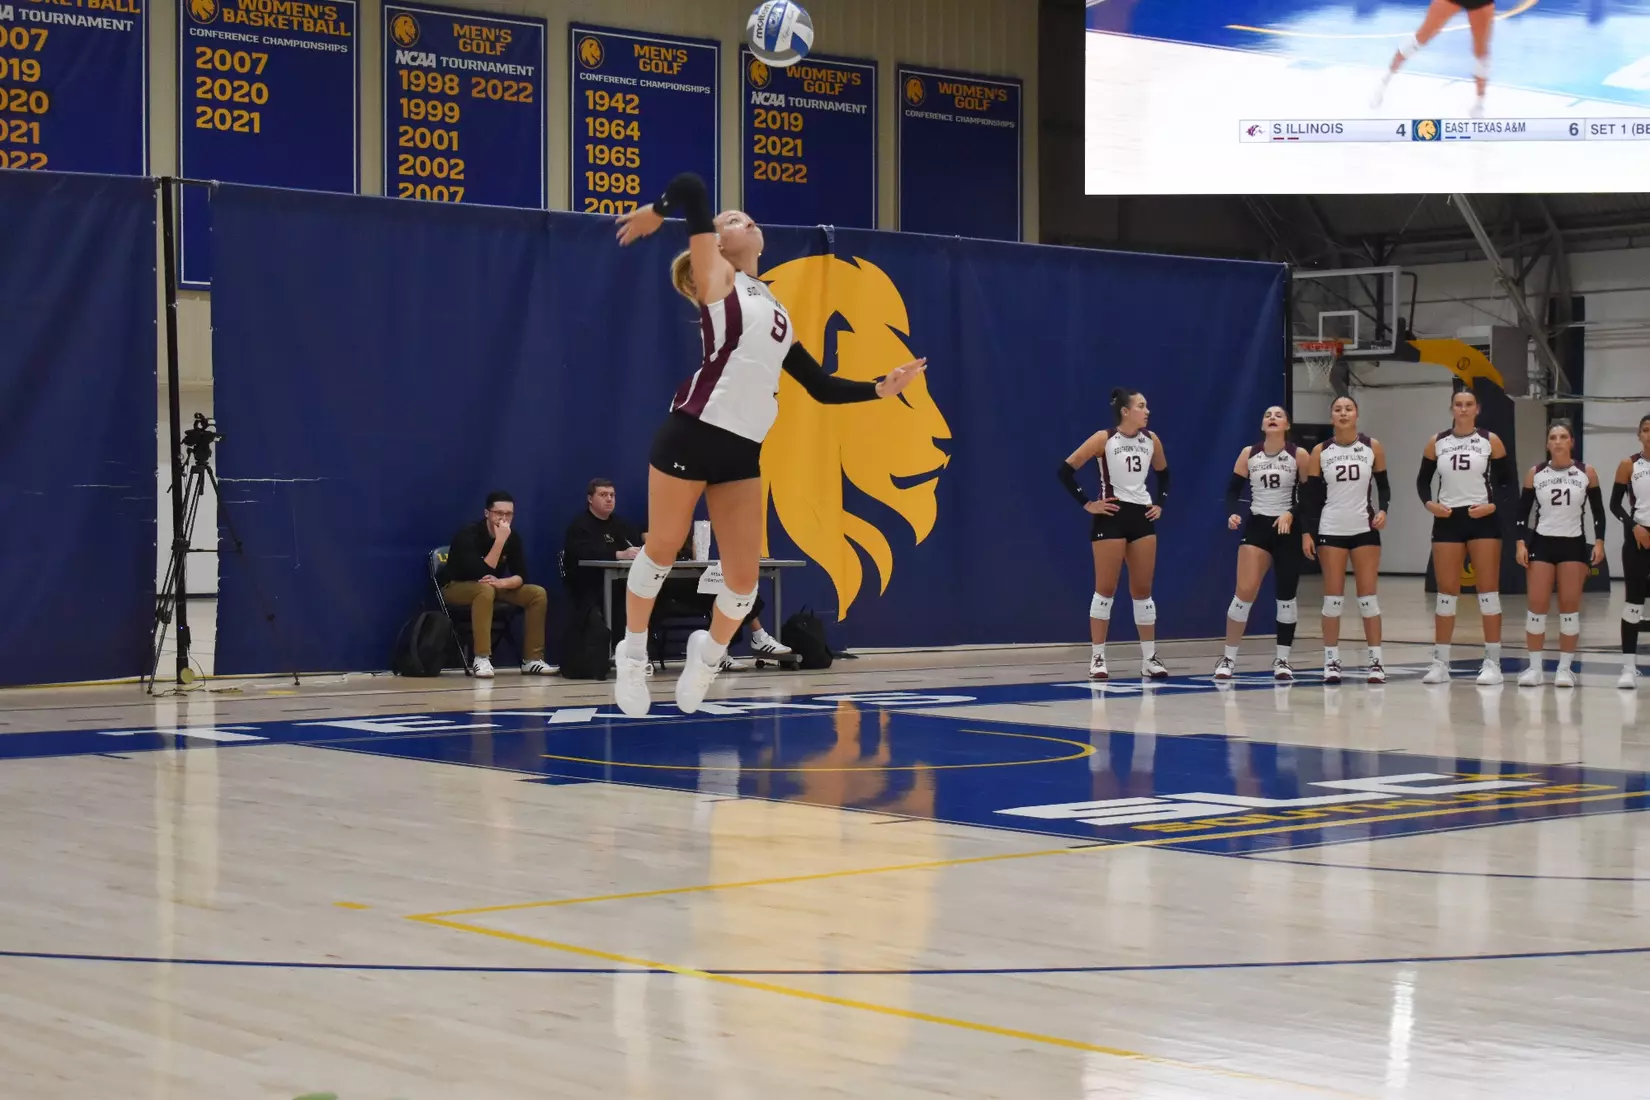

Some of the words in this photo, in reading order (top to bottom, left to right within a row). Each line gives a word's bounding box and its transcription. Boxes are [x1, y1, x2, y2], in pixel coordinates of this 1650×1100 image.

[19, 9, 134, 31] TOURNAMENT
[237, 0, 338, 20] WOMEN'S
[222, 8, 351, 36] BASKETBALL
[452, 23, 512, 43] MEN'S
[189, 27, 260, 43] CONFERENCE
[262, 36, 348, 53] CHAMPIONSHIPS
[458, 38, 506, 56] GOLF
[195, 46, 269, 75] 2007
[395, 50, 437, 69] NCAA
[440, 56, 534, 77] TOURNAMENT
[633, 44, 688, 63] MEN'S
[638, 58, 683, 75] GOLF
[787, 65, 862, 85] WOMEN'S
[195, 76, 269, 105] 2020
[399, 69, 460, 96] 1998
[471, 77, 533, 103] 2022
[579, 72, 638, 86] CONFERENCE
[639, 79, 711, 94] CHAMPIONSHIPS
[804, 79, 844, 96] GOLF
[937, 81, 1008, 102] WOMEN'S
[399, 98, 461, 124] 1999
[585, 89, 640, 115] 1942
[750, 91, 786, 108] NCAA
[787, 97, 868, 115] TOURNAMENT
[954, 96, 991, 111] GOLF
[195, 106, 261, 133] 2021
[585, 117, 641, 141] 1964
[753, 109, 803, 132] 2019
[905, 109, 953, 122] CONFERENCE
[955, 115, 1015, 129] CHAMPIONSHIPS
[1273, 123, 1283, 134] S
[1286, 123, 1344, 134] ILLINOIS
[1396, 124, 1407, 136] 4
[1445, 122, 1470, 134] EAST
[1472, 122, 1503, 133] TEXAS
[1504, 122, 1527, 133] A&M
[1569, 122, 1579, 136] 6
[1590, 123, 1616, 135] SET
[1620, 123, 1626, 134] 1
[399, 125, 459, 151] 2001
[753, 135, 803, 157] 2021
[398, 154, 465, 180] 2002
[585, 144, 641, 168] 1965
[753, 160, 808, 183] 2022
[398, 182, 465, 204] 2007
[585, 171, 641, 195] 1998
[584, 197, 638, 215] 2017
[770, 309, 788, 343] 9
[1125, 455, 1142, 472] 13
[1335, 464, 1360, 482] 20
[1450, 454, 1471, 471] 15
[1260, 473, 1280, 489] 18
[1551, 488, 1571, 506] 21
[993, 772, 1547, 826] SLC
[1130, 783, 1618, 833] SOUTHLAND
